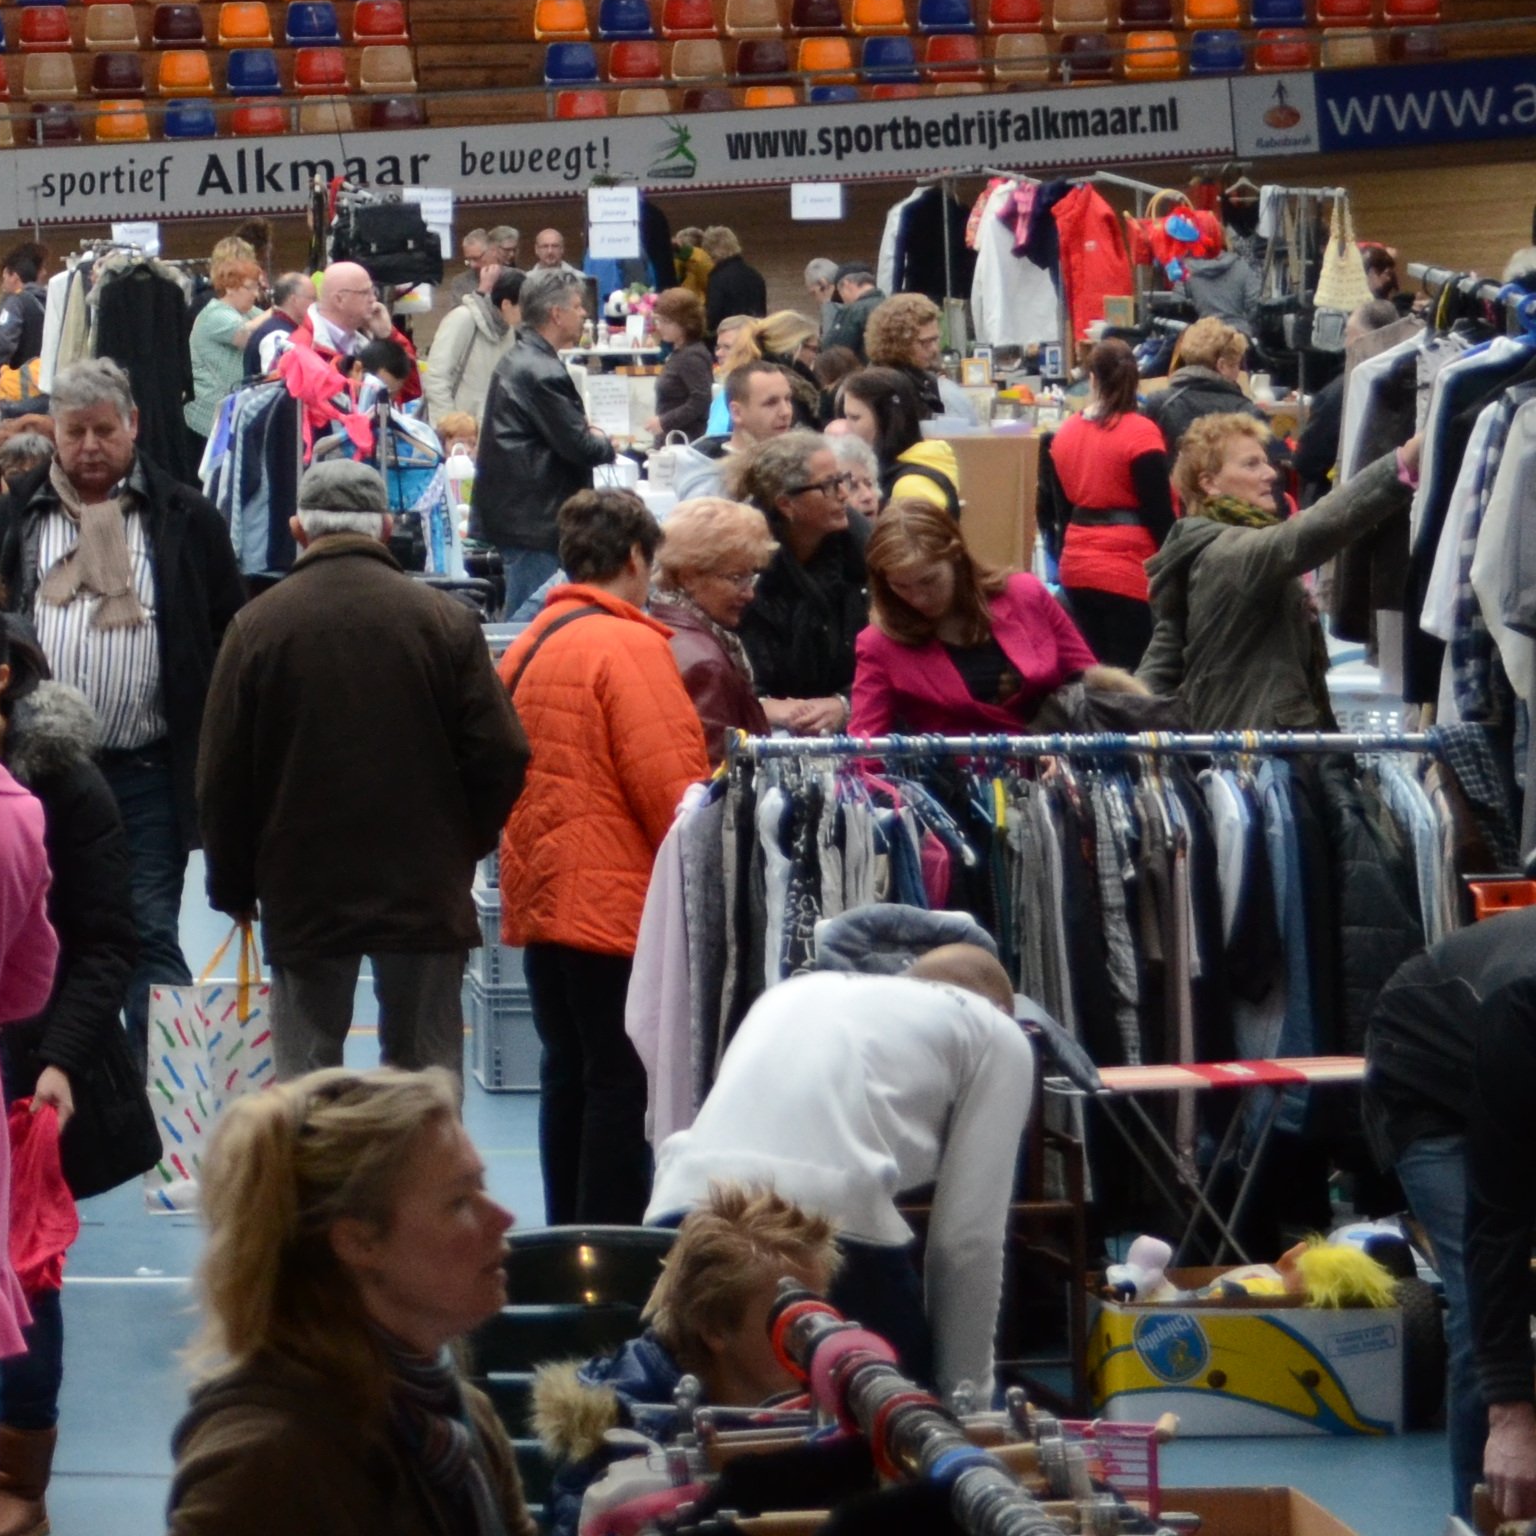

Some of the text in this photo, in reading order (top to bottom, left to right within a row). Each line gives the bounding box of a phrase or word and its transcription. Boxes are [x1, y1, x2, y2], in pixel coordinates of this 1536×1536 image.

[725, 96, 1178, 161] www.sportbedrijfalkmaar.nl
[41, 137, 611, 206] sportief Alkmaar beweegt!
